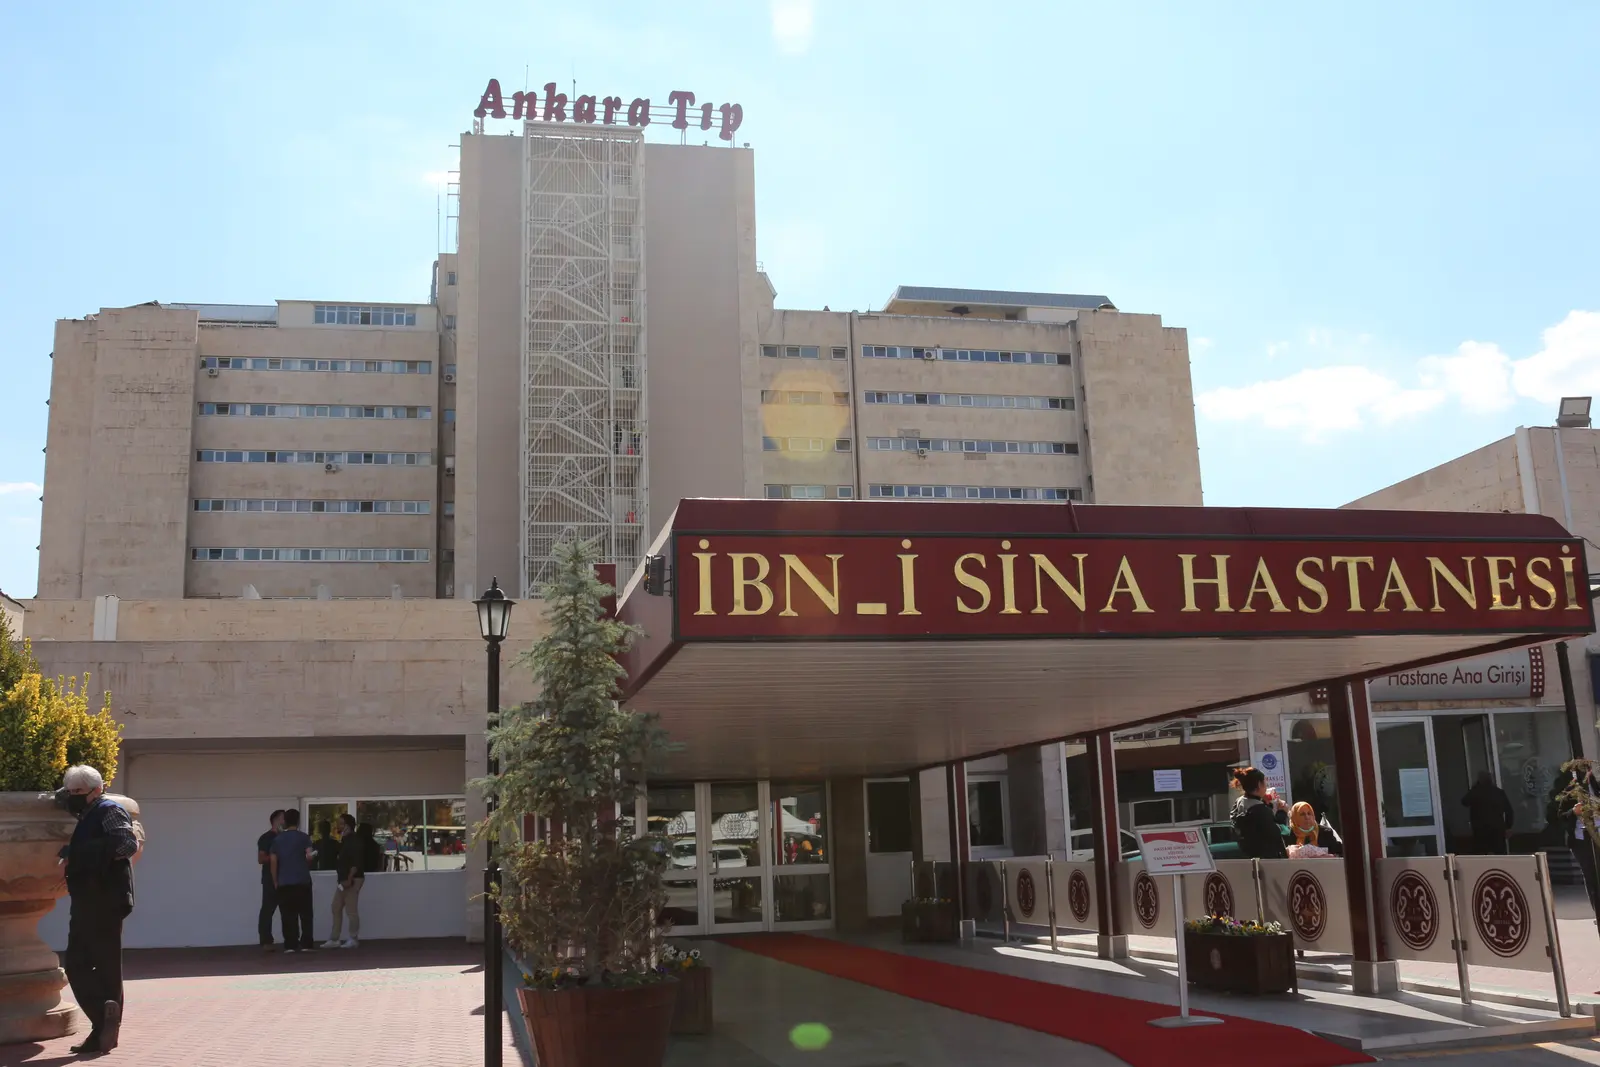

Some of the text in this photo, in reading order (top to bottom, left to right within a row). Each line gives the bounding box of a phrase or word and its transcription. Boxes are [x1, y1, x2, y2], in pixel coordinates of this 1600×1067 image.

[473, 78, 743, 141] Ankara Tıp
[953, 539, 1156, 615] SİNA
[1177, 544, 1583, 614] HASTANESİ
[1388, 665, 1526, 687] Hastane Ana Girişi
